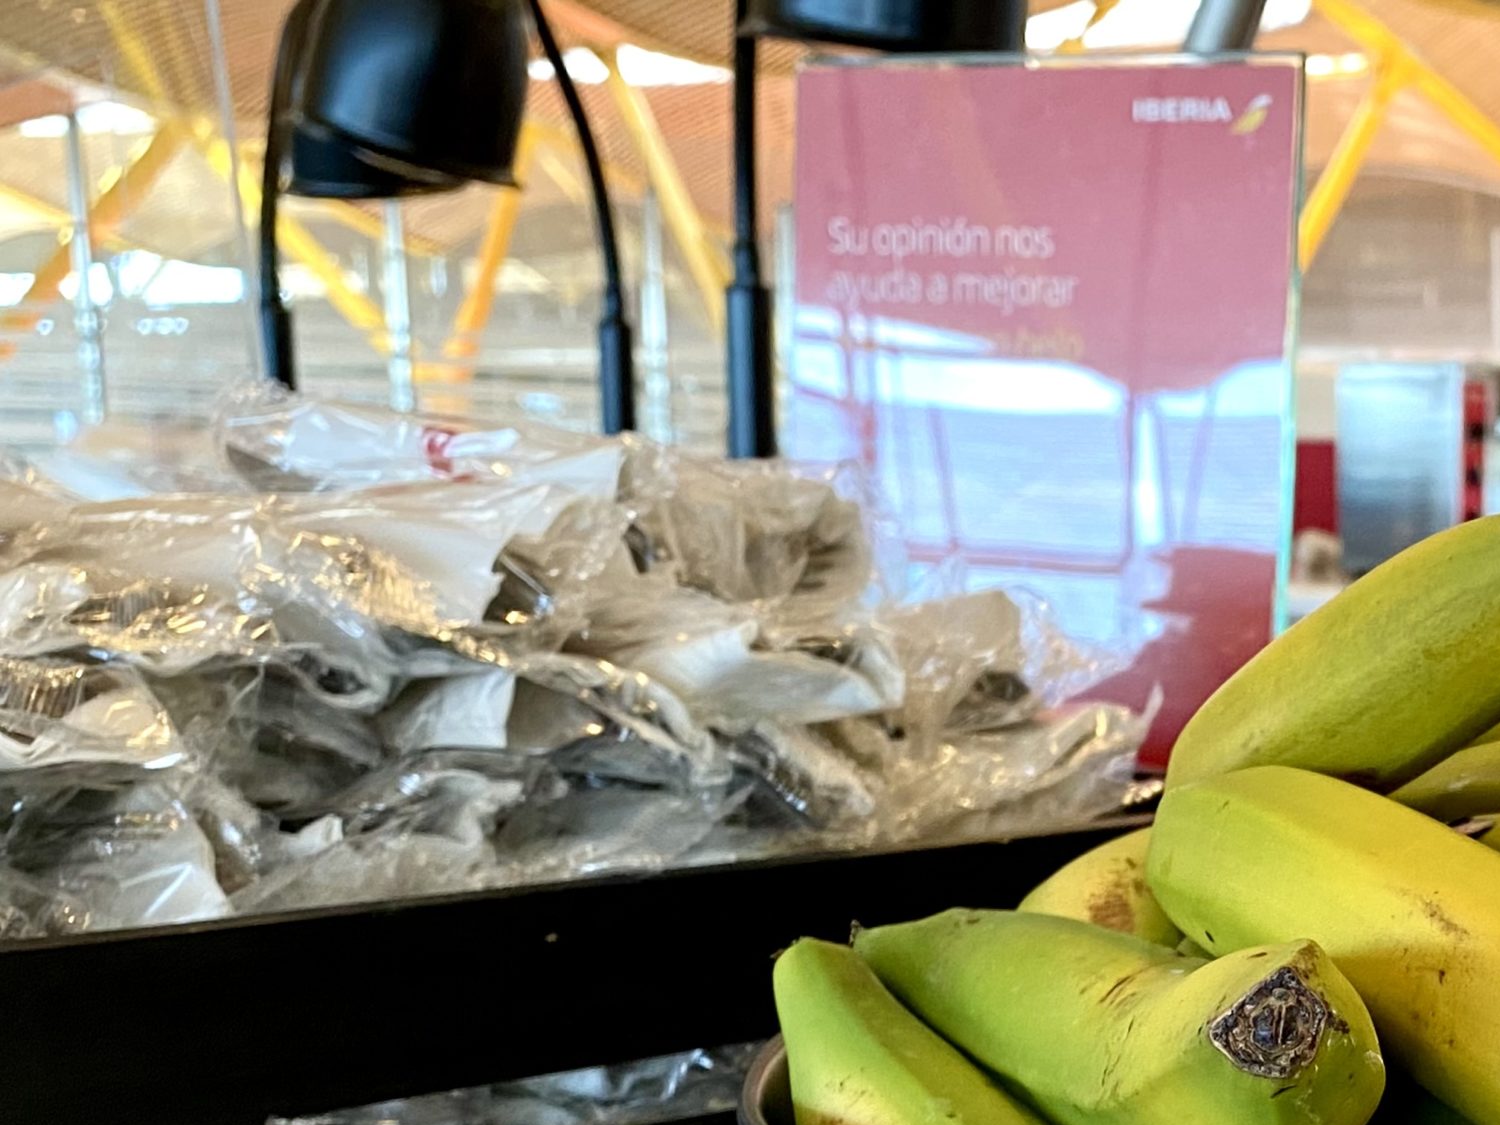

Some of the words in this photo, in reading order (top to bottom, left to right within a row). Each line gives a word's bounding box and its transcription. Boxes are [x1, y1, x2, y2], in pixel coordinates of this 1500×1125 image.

[1132, 96, 1233, 122] IBERIA
[828, 216, 869, 256] Su
[872, 215, 991, 266] opinión
[995, 225, 1055, 258] nos
[926, 272, 949, 305] a
[952, 265, 1078, 316] mejorar
